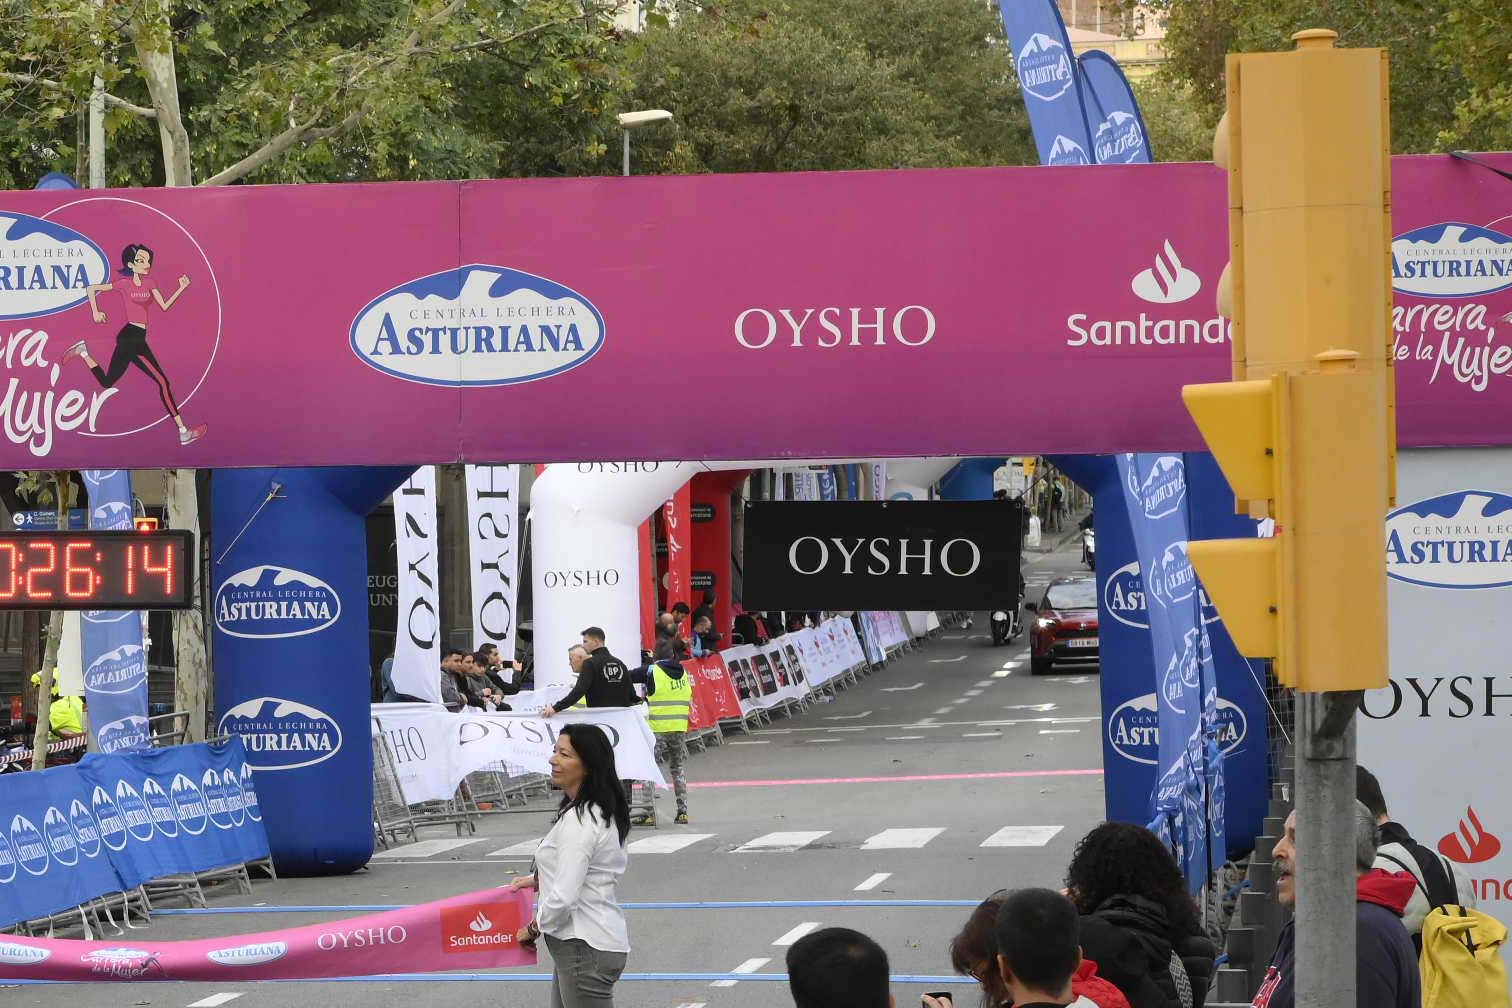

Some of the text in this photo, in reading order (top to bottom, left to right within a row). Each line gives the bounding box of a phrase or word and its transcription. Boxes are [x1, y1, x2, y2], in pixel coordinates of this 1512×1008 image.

[13, 247, 85, 258] LECHERA
[409, 306, 577, 320] CENTRAL LECHERA
[370, 312, 585, 356] ASTURIANA
[734, 304, 937, 350] OYSHO
[1416, 333, 1434, 361] la
[1412, 525, 1480, 535] CENTRAL
[788, 536, 982, 577] OYSHO
[544, 568, 619, 588] OYSHO
[231, 589, 327, 598] CENTRAL LECHERA
[219, 596, 331, 622] ASTURIANA
[608, 667, 618, 676] BP
[233, 722, 273, 730] CENTRAL
[317, 925, 407, 951] OYSHO
[449, 931, 513, 948] Santander
